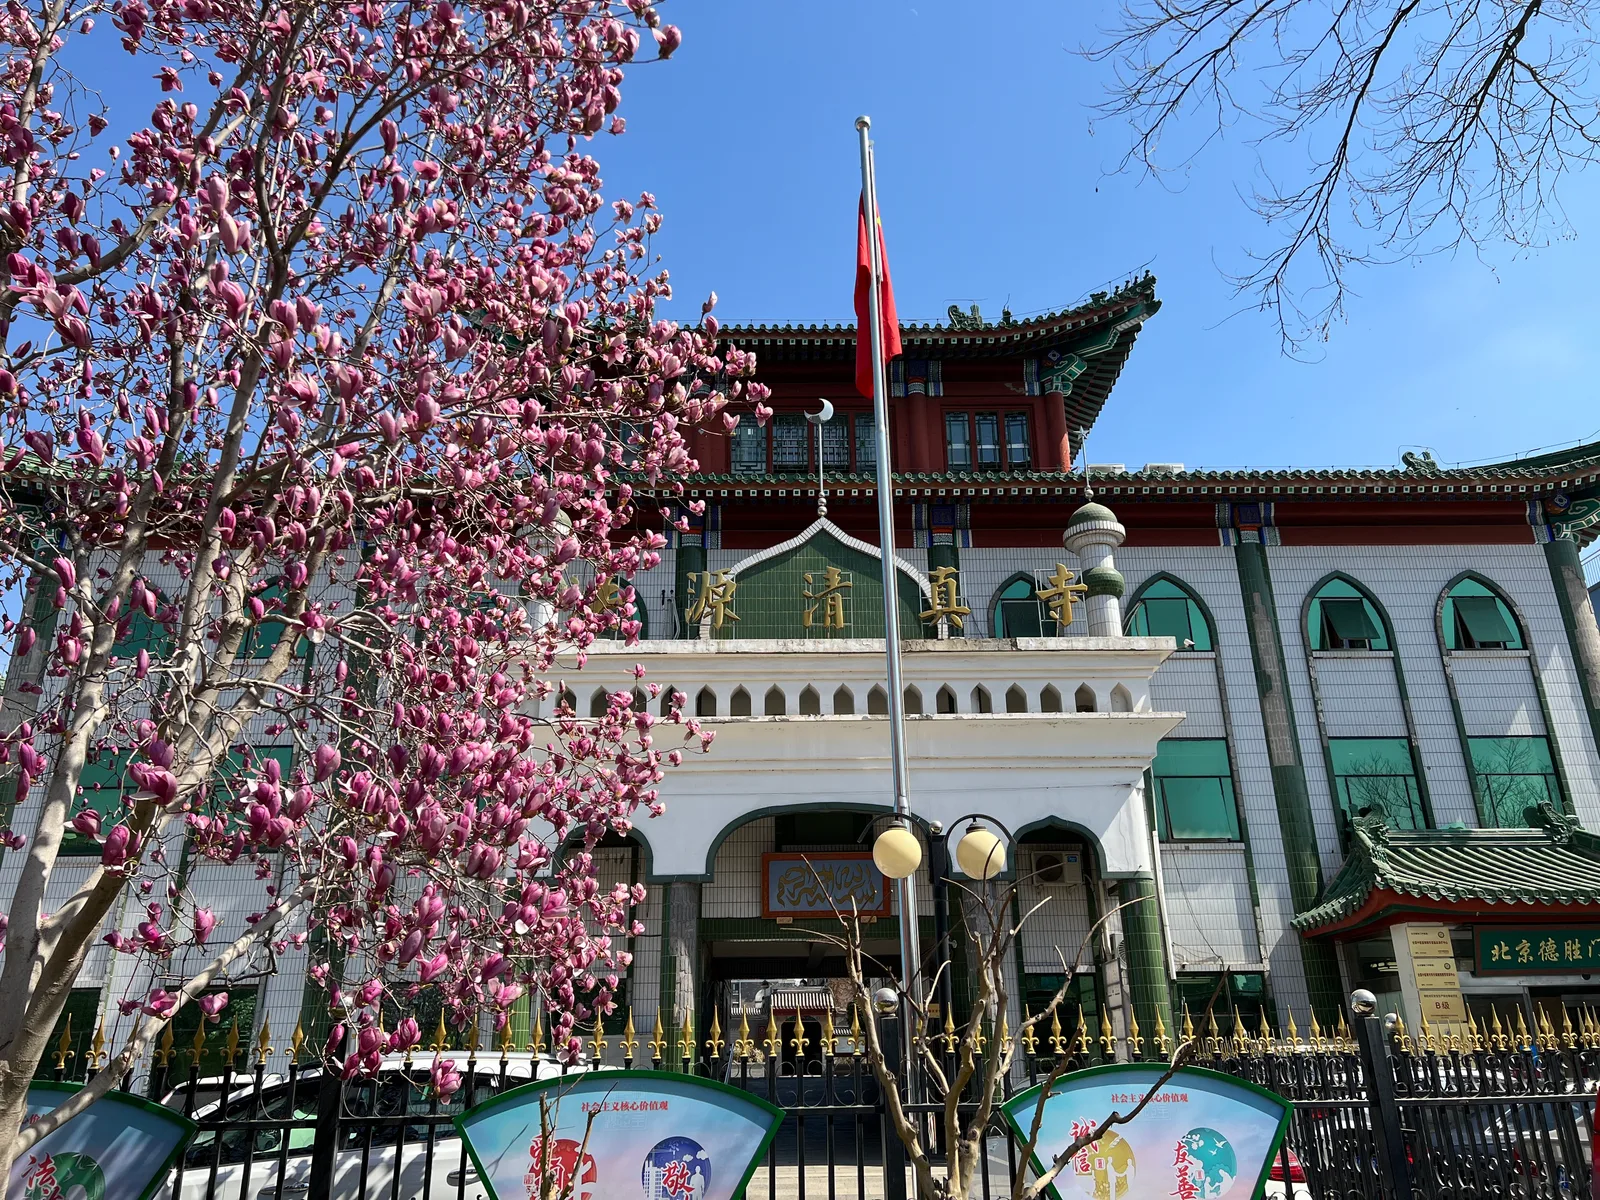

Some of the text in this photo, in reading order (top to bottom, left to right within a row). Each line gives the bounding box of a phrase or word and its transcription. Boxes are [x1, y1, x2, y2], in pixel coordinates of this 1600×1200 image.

[1435, 1001, 1450, 1010] B级
[1111, 1092, 1189, 1104] 社会主义心价值观
[581, 1100, 668, 1113] 社会主义核心价值观
[1169, 1140, 1200, 1200] 友善
[661, 1161, 695, 1200] 敬
